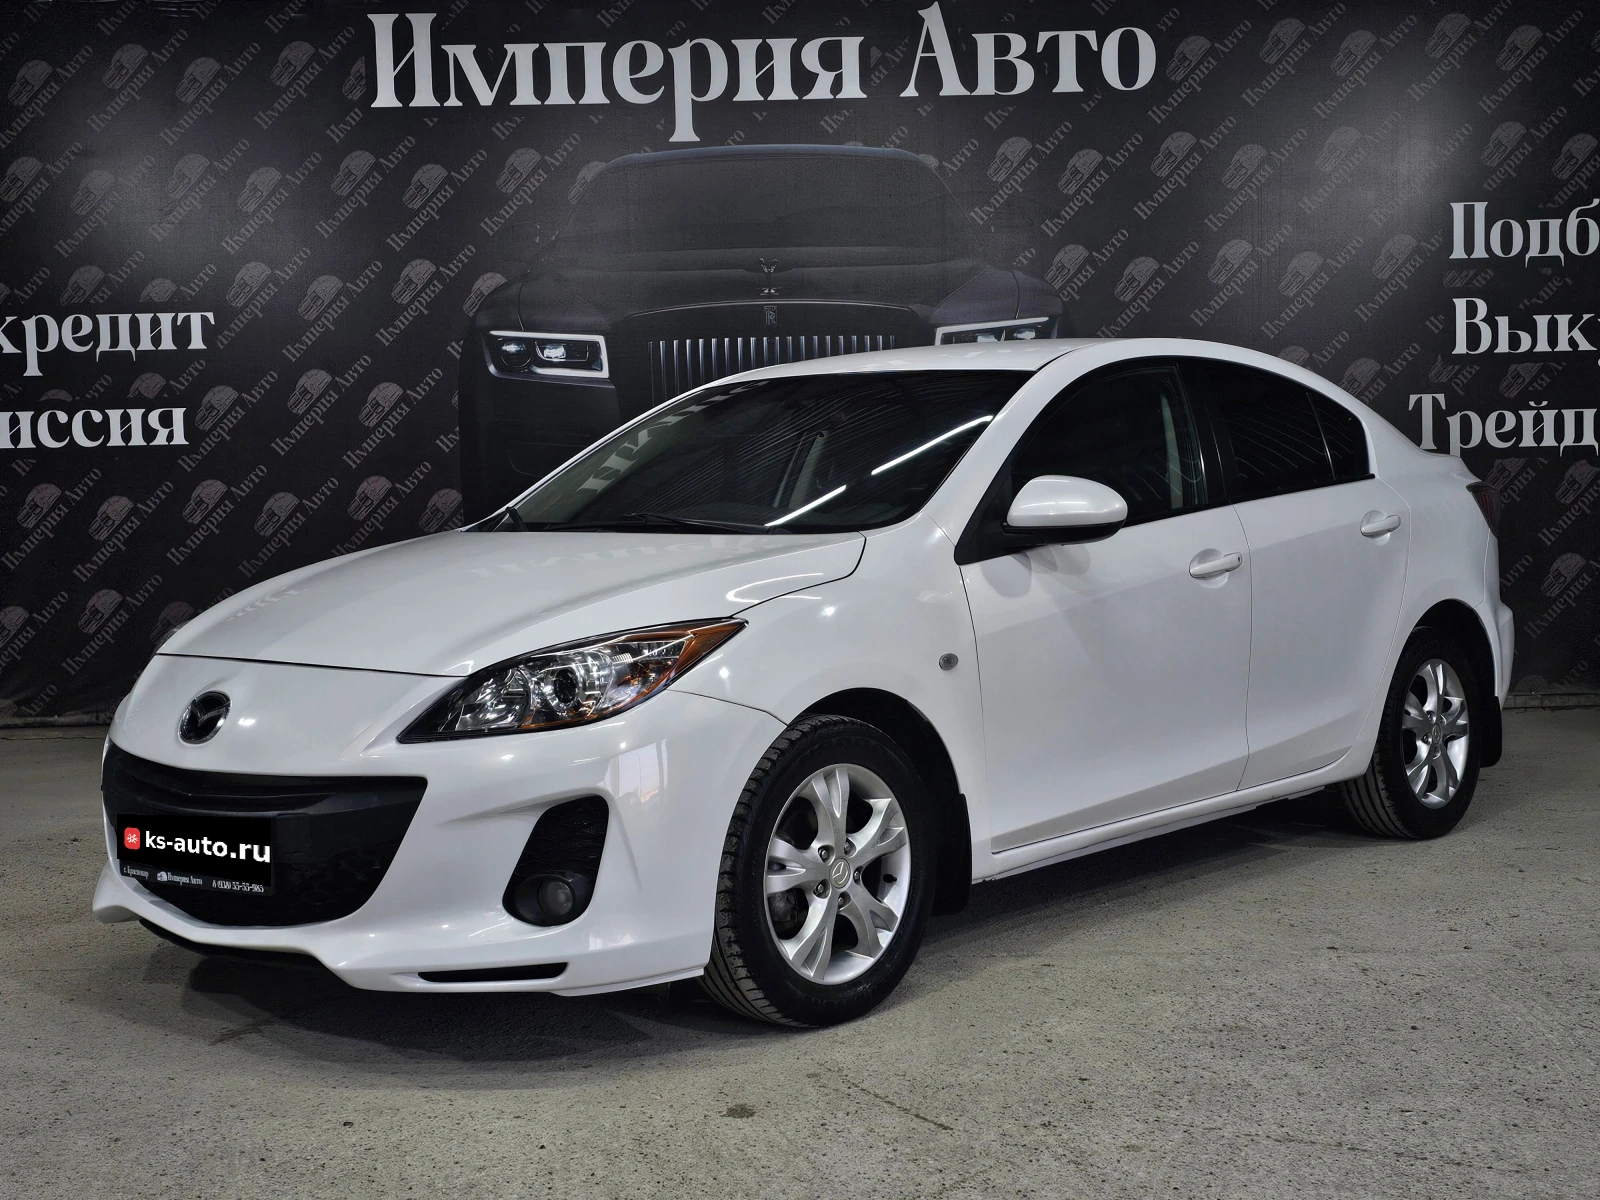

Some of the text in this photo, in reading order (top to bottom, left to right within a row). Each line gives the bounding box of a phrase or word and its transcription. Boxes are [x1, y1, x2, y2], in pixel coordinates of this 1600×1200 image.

[55, 46, 94, 83] Авто
[86, 68, 157, 134] Империя
[149, 29, 189, 67] Авто
[159, 80, 228, 146] Империя
[223, 42, 261, 80] Авто
[253, 65, 324, 131] Империя
[317, 26, 355, 64] Авто
[367, 1, 1157, 142] Империя Авто
[1147, 19, 1252, 124] Империя Авто
[1241, 3, 1347, 108] Империя Авто
[1311, 15, 1418, 120] Империя Авто
[1407, 37, 1478, 103] Империя
[1477, 8, 1584, 115] Империя Авто
[0, 141, 83, 236] мперия Авто
[214, 139, 251, 176] Авто
[315, 175, 384, 239] Империя
[377, 136, 417, 174] Авто
[480, 172, 549, 236] Империя
[543, 134, 582, 171] Авто
[941, 138, 979, 176] Авто
[968, 159, 1040, 226] Империя
[1033, 121, 1073, 159] Авто
[1039, 171, 1111, 238] Империя
[1105, 133, 1143, 171] Авто
[1133, 115, 1237, 221] Империя Авто
[1203, 127, 1308, 233] Империя Авто
[1482, 106, 1568, 191] перия Авто
[221, 152, 322, 255] Империя Авто
[386, 149, 488, 252] Империя Авто
[1254, 224, 1294, 262] Авто
[1449, 198, 1600, 268] Подб
[12, 267, 51, 304] Авто
[109, 251, 146, 288] Авто
[181, 264, 218, 301] Авто
[272, 247, 312, 285] Авто
[375, 245, 477, 347] Империя Авто
[1059, 229, 1130, 303] ерия Авто
[1161, 240, 1200, 279] Авто
[1325, 236, 1365, 274] Авто
[1353, 256, 1425, 323] Империя
[282, 261, 384, 363] Империя Авто
[1451, 297, 1600, 367] Вык
[80, 374, 113, 402] вто
[169, 358, 206, 395] Авто
[240, 371, 279, 408] Авто
[271, 355, 372, 457] Империя Авто
[1382, 343, 1421, 380] Авто
[341, 368, 444, 469] Империя Авто
[1408, 392, 1600, 458] Трейд
[1, 507, 70, 571] Империя
[64, 468, 102, 506] Авто
[165, 501, 235, 566] Империя
[229, 465, 268, 502] Авто
[303, 478, 340, 515] Авто
[394, 462, 432, 498] Авто
[71, 480, 174, 582] Империя Авто
[32, 591, 69, 628] Авто
[61, 575, 164, 676] Империя Авто
